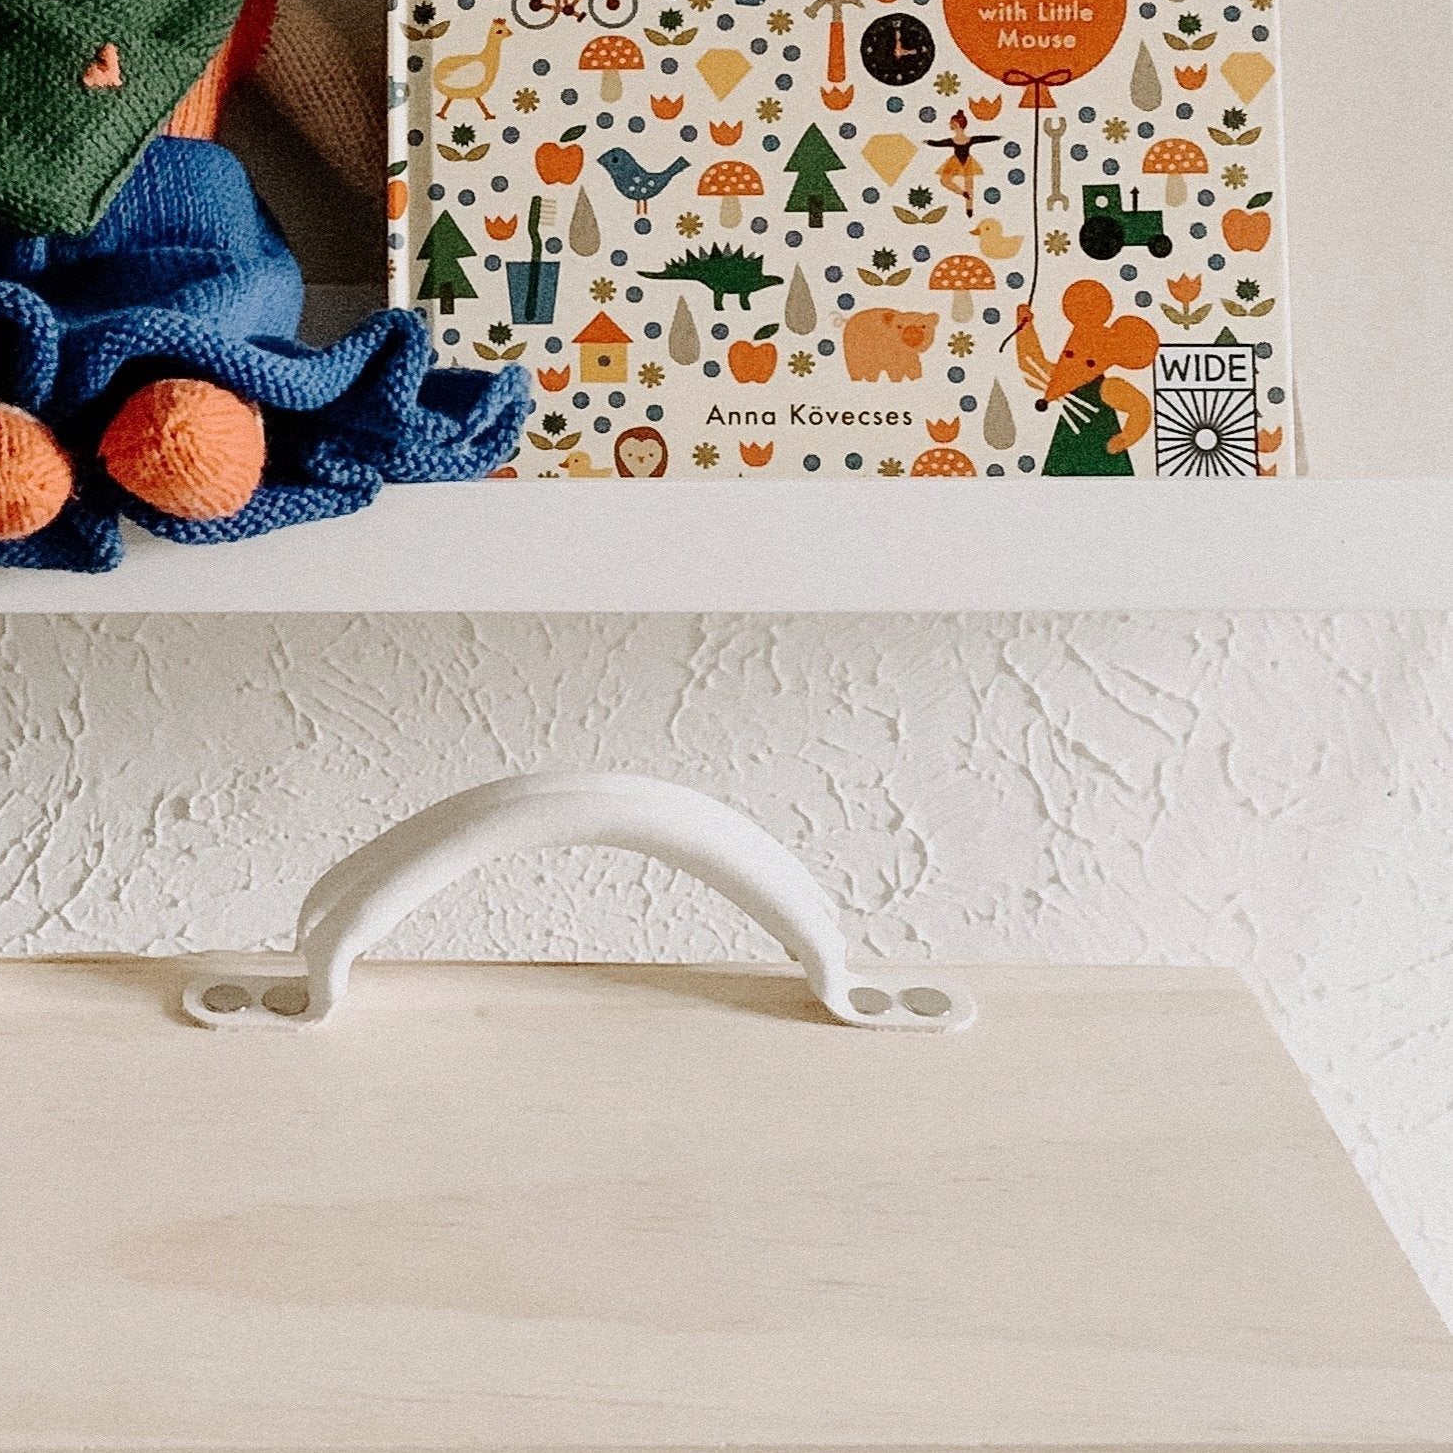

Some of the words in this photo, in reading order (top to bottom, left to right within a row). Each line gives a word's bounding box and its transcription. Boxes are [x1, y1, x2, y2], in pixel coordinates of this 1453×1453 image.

[978, 1, 1027, 21] with
[1037, 0, 1094, 22] Little
[997, 28, 1077, 49] Mouse
[1159, 353, 1247, 382] WIDE
[705, 404, 776, 426] Anna
[790, 403, 913, 426] Kövecses
